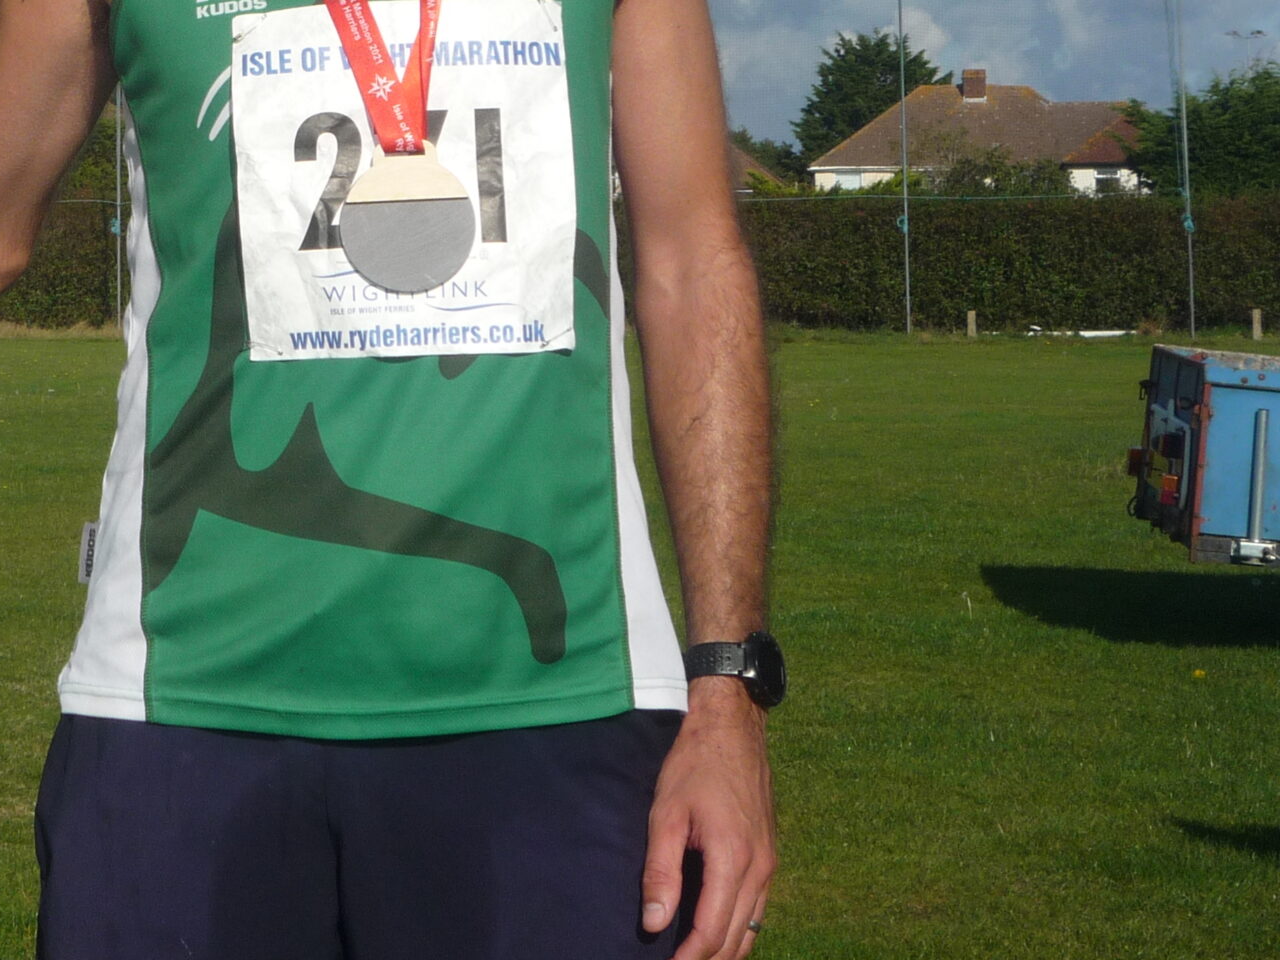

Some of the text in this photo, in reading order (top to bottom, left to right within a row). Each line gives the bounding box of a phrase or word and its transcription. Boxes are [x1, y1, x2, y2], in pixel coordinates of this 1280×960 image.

[342, 5, 361, 41] Harriers
[353, 2, 373, 46] Marathon
[369, 44, 384, 65] 2021
[242, 48, 293, 77] ISLE
[301, 46, 331, 72] OF
[433, 40, 562, 68] MARATHON
[392, 104, 402, 120] Isle
[400, 121, 409, 131] of
[330, 304, 415, 316] ISLE OF WIGHT FERRIES
[290, 319, 545, 351] www.rydeharriers.co.uk
